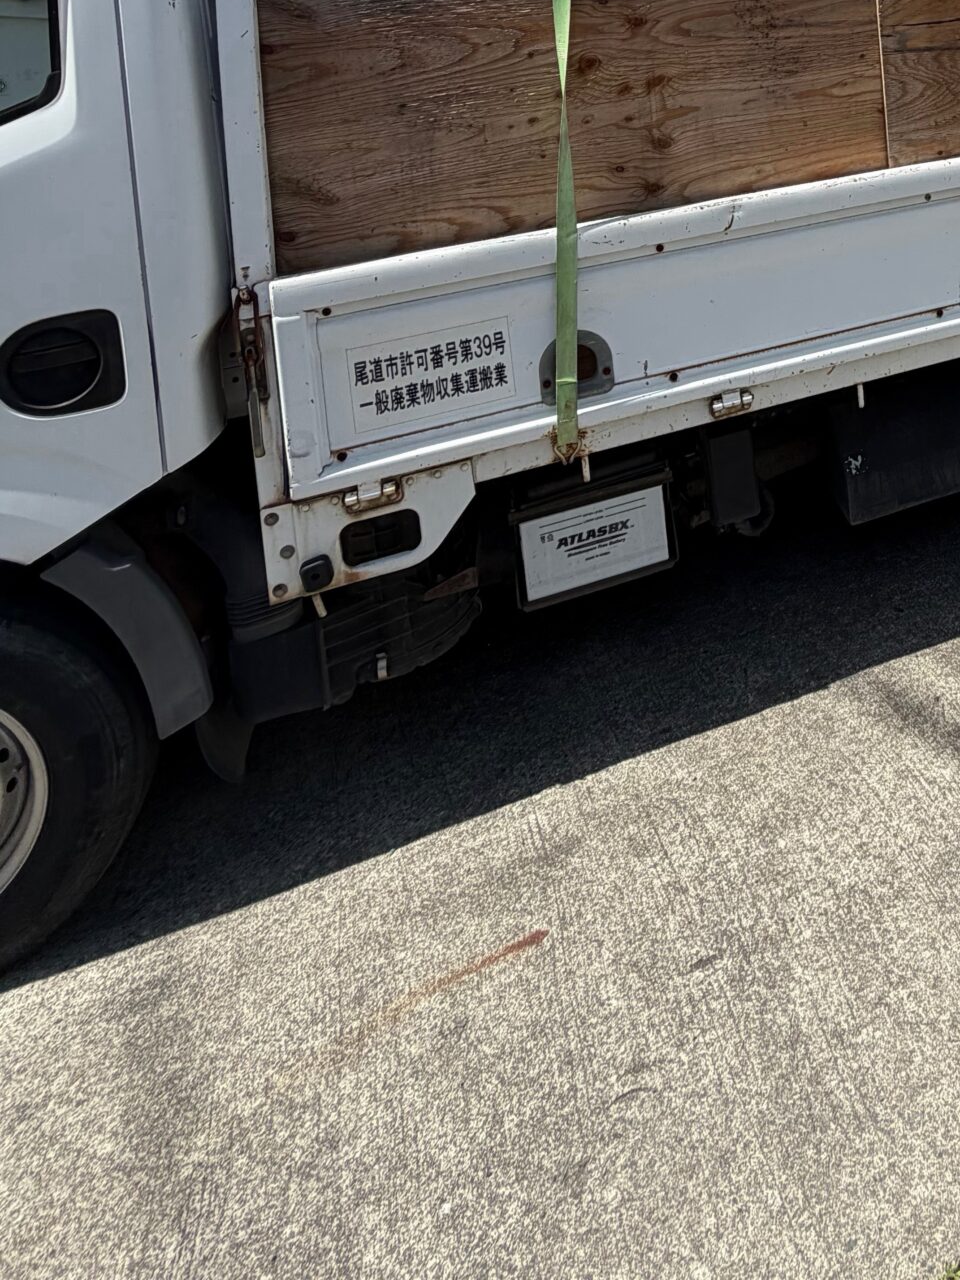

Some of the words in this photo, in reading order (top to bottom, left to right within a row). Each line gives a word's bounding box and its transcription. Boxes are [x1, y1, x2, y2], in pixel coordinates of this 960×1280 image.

[354, 331, 506, 387] 尾道市許可番号第39号
[359, 362, 509, 416] 一般廃棄物収集運搬業
[556, 519, 631, 550] ATLASBX
